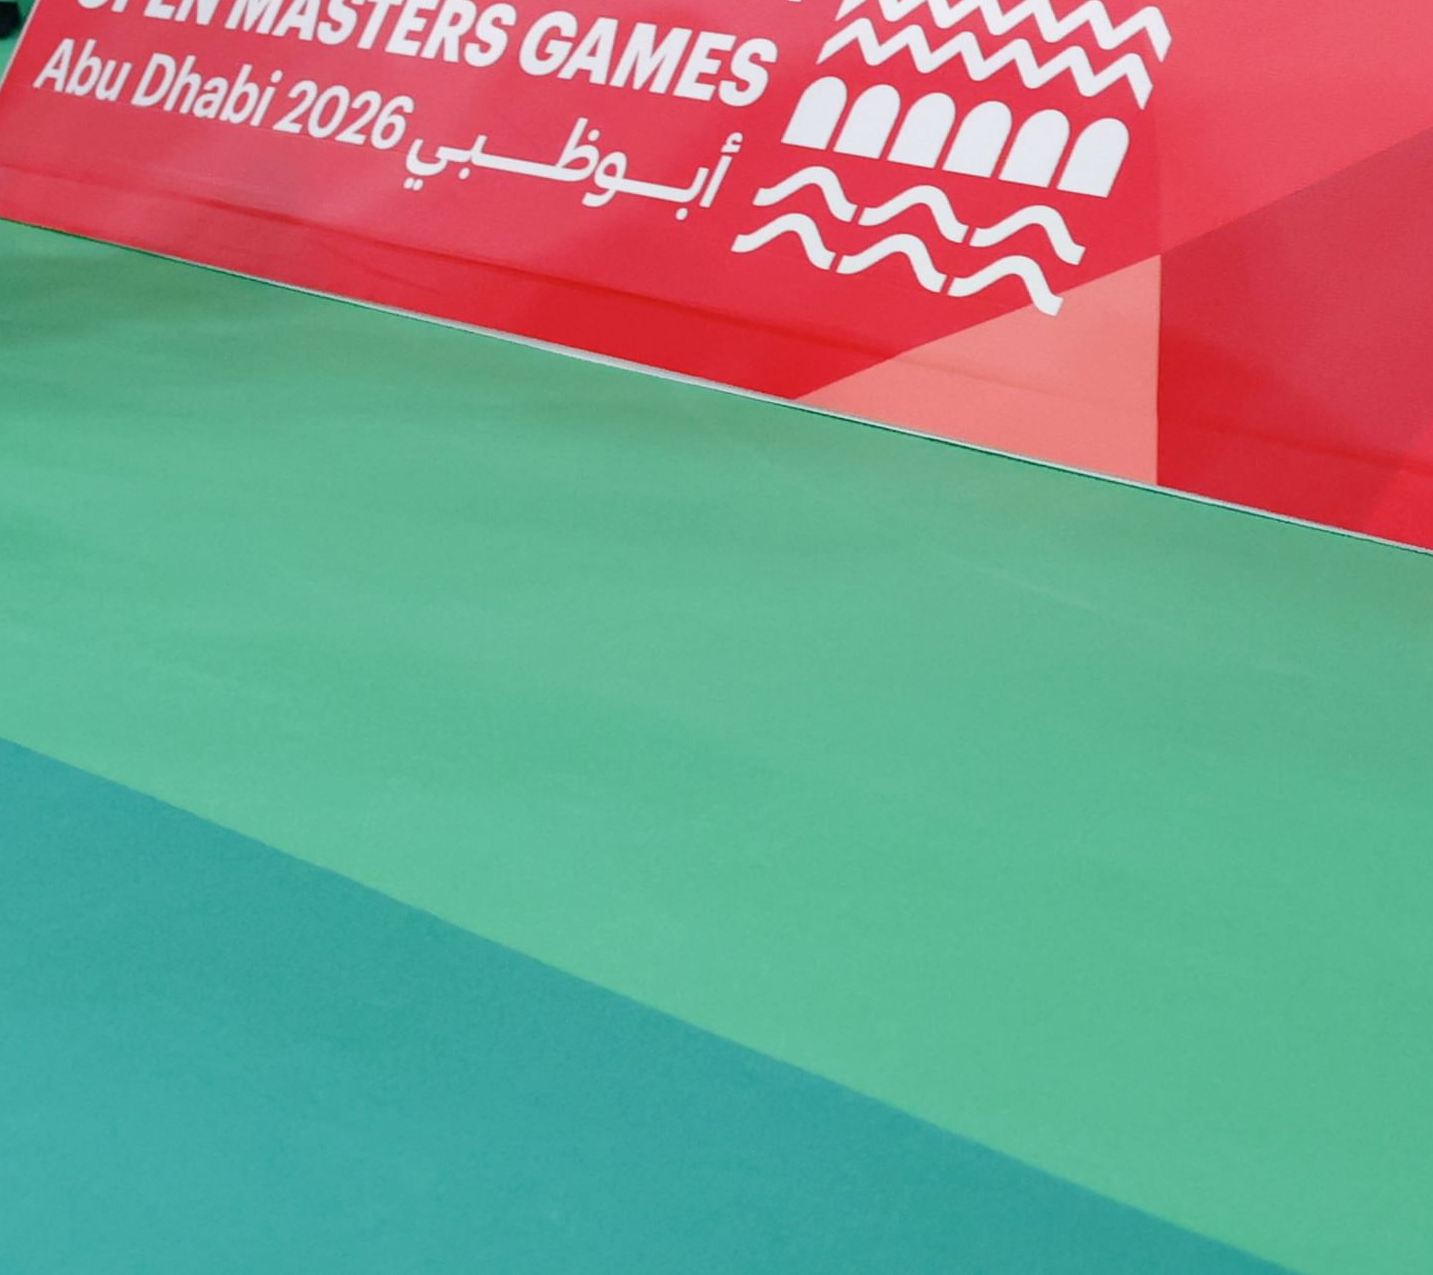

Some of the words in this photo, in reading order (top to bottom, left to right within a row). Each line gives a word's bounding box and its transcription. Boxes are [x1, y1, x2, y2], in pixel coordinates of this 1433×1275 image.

[519, 10, 778, 108] GAMES
[33, 38, 131, 101] Abu
[131, 52, 283, 127] Dhabi
[272, 80, 414, 150] 2026
[403, 117, 743, 221] أبوظبي
